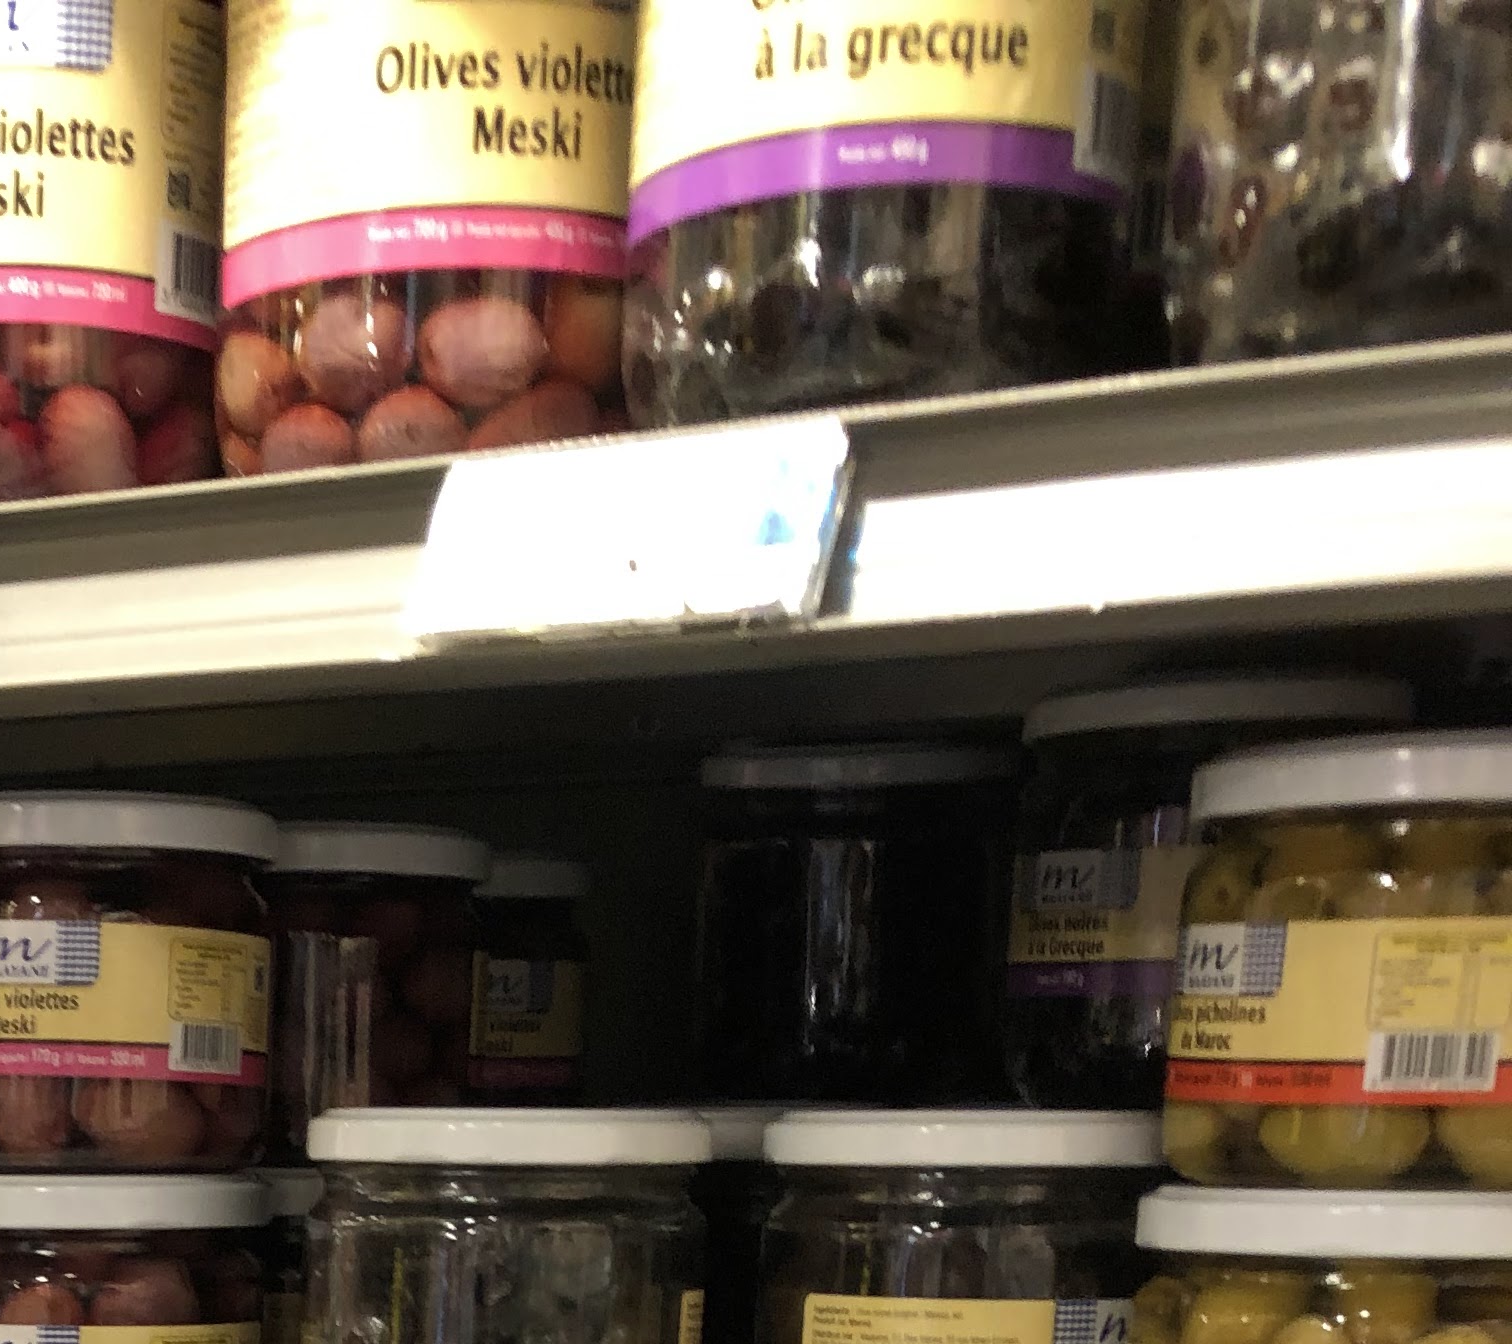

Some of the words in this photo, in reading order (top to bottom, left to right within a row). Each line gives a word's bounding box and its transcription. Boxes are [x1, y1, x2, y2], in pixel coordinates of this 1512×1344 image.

[377, 44, 500, 94] Olives
[794, 23, 829, 69] la
[850, 18, 1030, 78] grecque
[472, 106, 583, 160] Meski
[7, 987, 79, 1011] violettes
